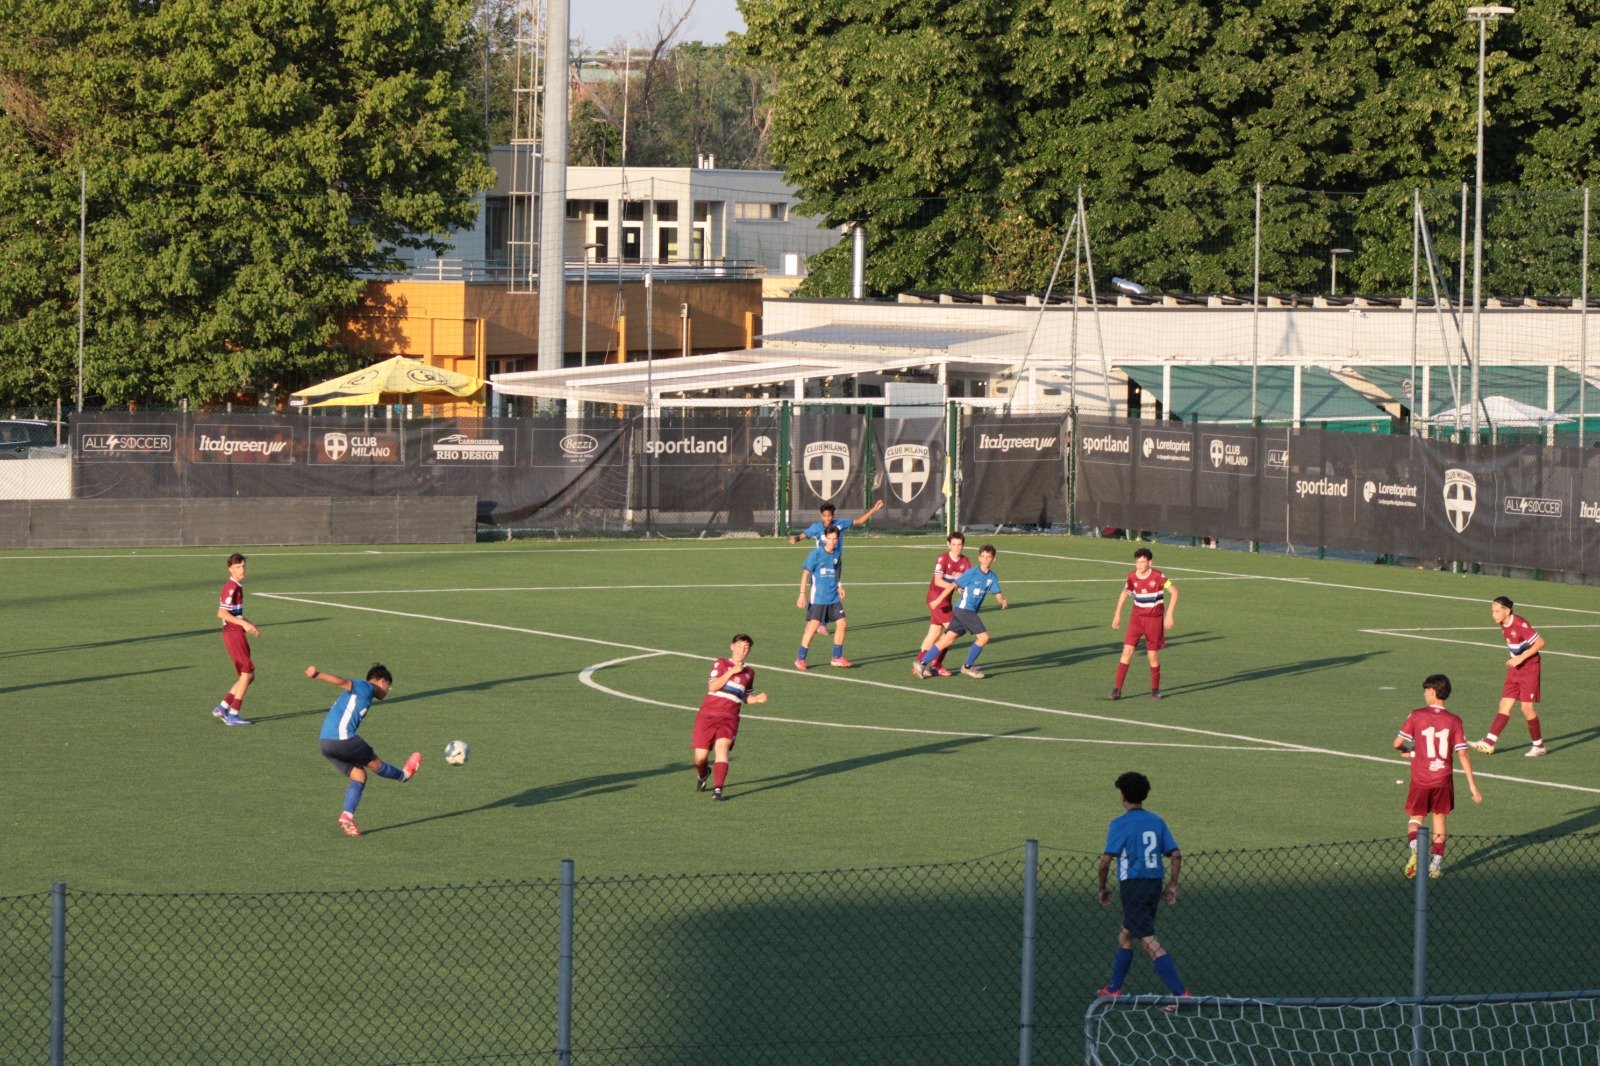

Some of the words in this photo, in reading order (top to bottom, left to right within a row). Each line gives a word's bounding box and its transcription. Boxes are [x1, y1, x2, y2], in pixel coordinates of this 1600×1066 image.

[199, 435, 274, 455] Italgreen
[351, 436, 377, 447] CLUB
[563, 438, 593, 449] Bezzi
[646, 436, 727, 458] sportland
[806, 444, 823, 452] CLUB
[824, 443, 847, 453] MILANO
[979, 434, 1044, 452] Italgreen
[1083, 435, 1130, 454] sportland
[1156, 438, 1190, 453] Loretoprint
[351, 447, 390, 457] MILANO
[436, 451, 459, 460] RHO
[461, 451, 500, 460] DESIGN
[887, 446, 902, 456] CLUB
[904, 446, 928, 456] MILANO
[1225, 444, 1240, 455] CLUB
[1225, 455, 1248, 466] MILANO
[1296, 477, 1348, 498] sportland
[1379, 482, 1417, 498] Loretoprint
[1421, 726, 1450, 759] 11
[1142, 831, 1158, 868] 2
